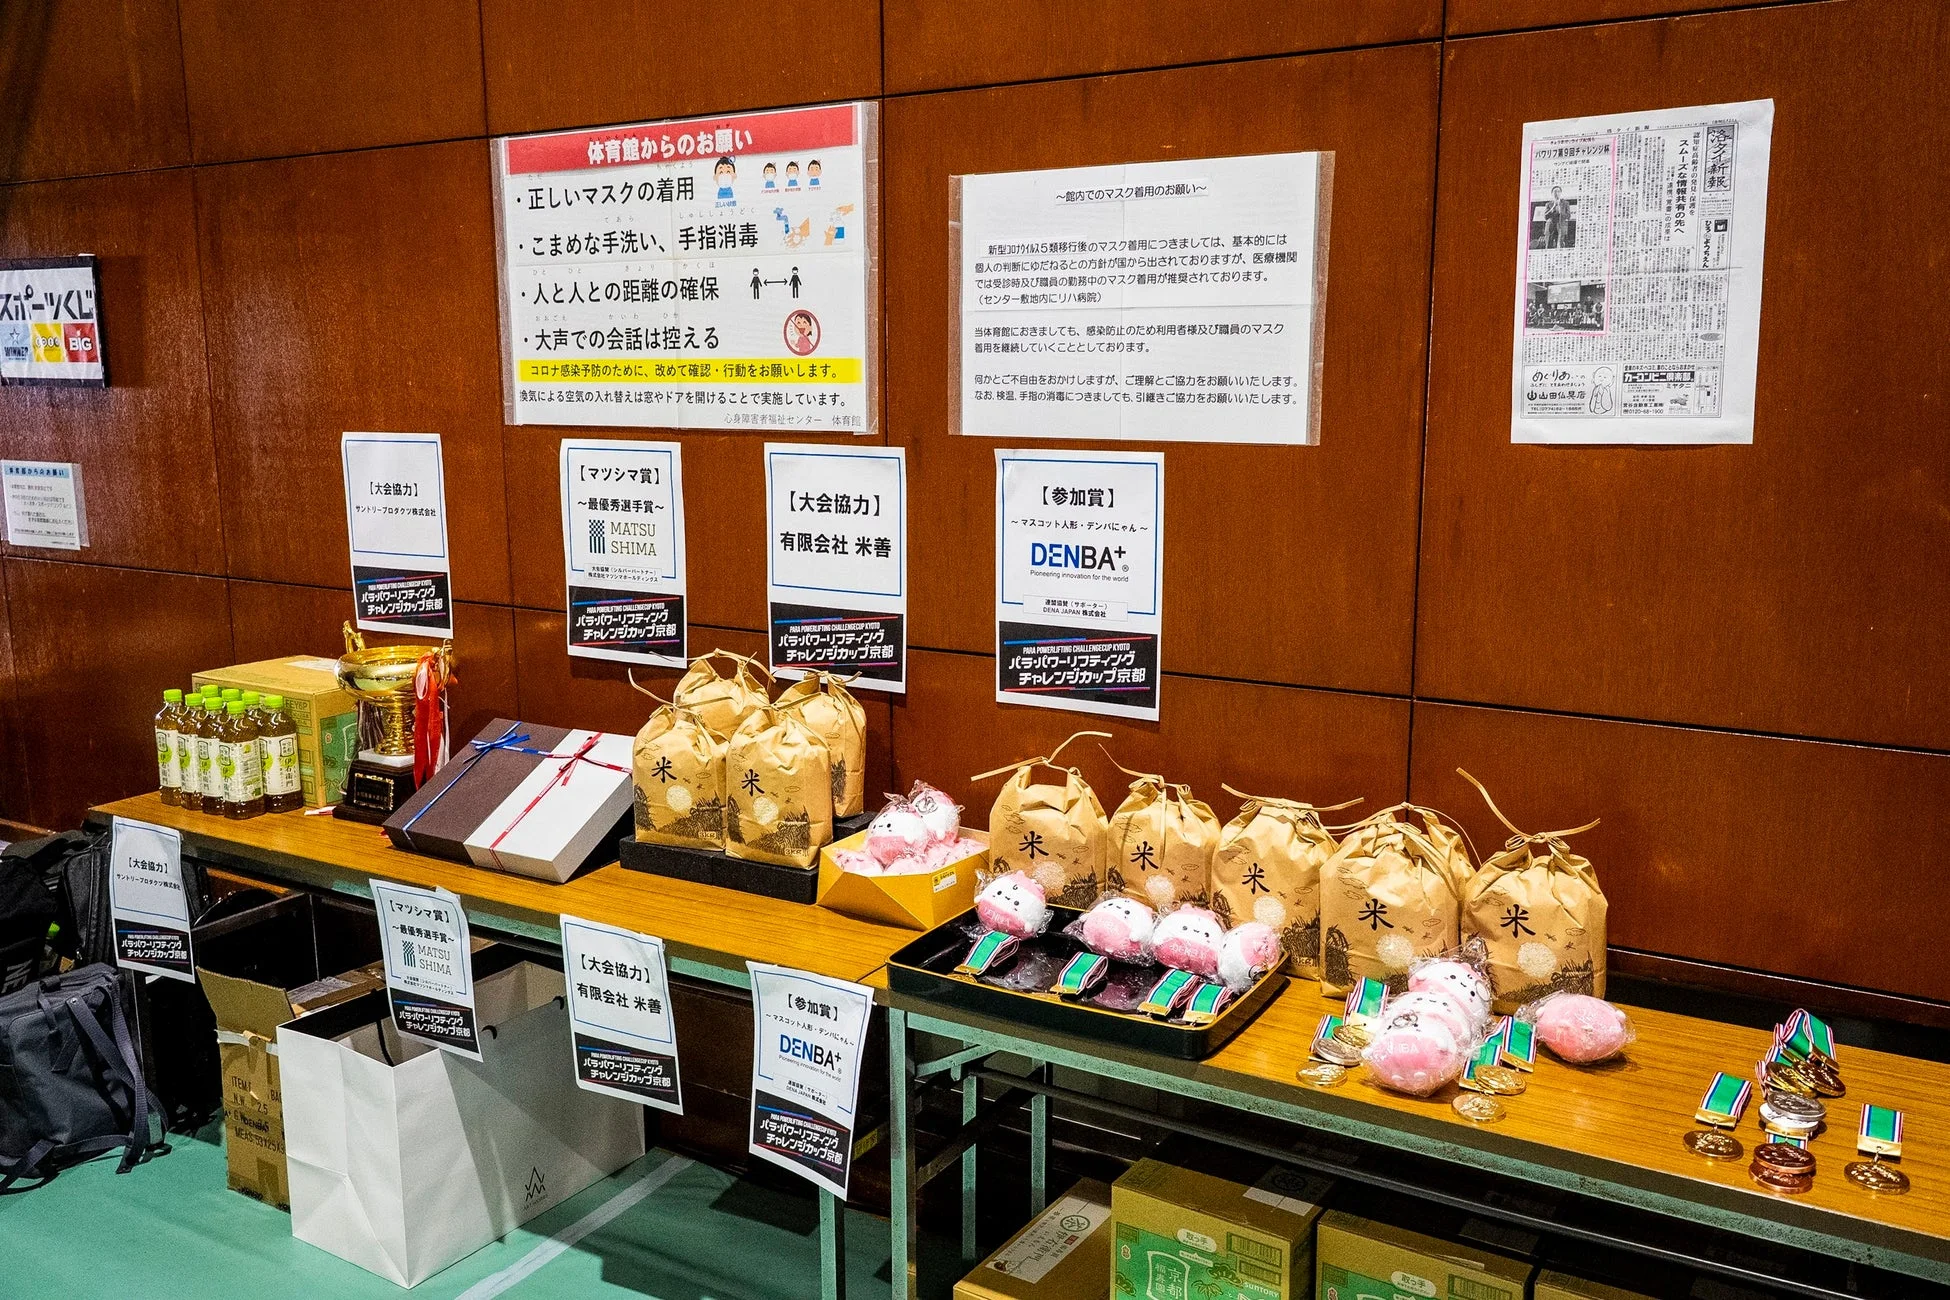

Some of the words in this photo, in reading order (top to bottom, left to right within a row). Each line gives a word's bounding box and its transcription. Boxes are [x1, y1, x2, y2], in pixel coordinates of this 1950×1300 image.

[587, 128, 753, 165] 体育館からのお願い
[1707, 129, 1732, 190] 洛タイ新報
[1674, 139, 1689, 233] スムーズな情報共有の先へ
[974, 323, 1285, 337] 当体育館におきましても、感染防止のため利用者様及び職員のマスク
[69, 337, 93, 351] BIG
[974, 341, 1150, 353] 着用を継続していくこととしております。
[530, 363, 837, 379] コロナ感染予防のために、改めて確認・行動をお願いします。
[974, 374, 1298, 387] 何かとご不自由をおかけしますが、ご理解とご協力をお願いいたします。
[519, 390, 846, 407] 換気による空気の入れ替えは窓やドアを開けることで実施しています。
[724, 413, 822, 426] 心身障害者福祉センター
[831, 415, 862, 427] 体育館
[580, 464, 660, 485] 【マツシマ賞】
[370, 481, 419, 498] 【大会協力】
[1042, 486, 1115, 508] 【参加賞】
[355, 505, 437, 517] サントリープロダクツ株式会社
[788, 490, 881, 517] 【大会協力】
[611, 521, 657, 538] MATSU
[611, 540, 658, 557] SHIMA
[780, 531, 849, 555] 有限会社
[854, 536, 892, 559] 米善
[1030, 569, 1061, 580] Pioneering
[1062, 572, 1092, 581] innovation
[1092, 573, 1102, 581] for
[1102, 573, 1112, 582] the
[1112, 575, 1129, 583] world
[367, 598, 443, 615] チャレンジカップ京都
[1043, 606, 1060, 615] DENA
[1061, 608, 1081, 617] JAPAN
[1082, 609, 1107, 618] 株式会社
[583, 623, 677, 641] チャレンジカップ京都
[789, 625, 801, 633] PARA
[800, 623, 831, 633] POWERLIFTING
[831, 622, 865, 631] CHALLENGECUP
[865, 621, 881, 630] KYOTO
[786, 645, 894, 663] チャレンジカップ京都
[1022, 646, 1036, 654] PARA
[1036, 644, 1072, 654] POWERLIFTING
[1072, 643, 1112, 653] CHALLENGECUP
[1112, 642, 1130, 651] KYOTO
[1018, 667, 1146, 686] チャレンジカップ京都
[651, 756, 677, 784] 米
[741, 768, 765, 797] 米
[1018, 830, 1049, 859] 米
[1130, 840, 1159, 871] 米
[129, 857, 168, 874] 【大会協力】
[1242, 863, 1271, 895] 米
[389, 900, 450, 924] 【マツシマ賞】
[1358, 898, 1395, 931] 米
[1500, 903, 1536, 938] 米
[417, 944, 451, 961] MATSU
[419, 958, 452, 976] SHIMA
[581, 953, 650, 984] 【大会協力】
[577, 983, 630, 1009] 有限会社
[634, 996, 662, 1015] 米善
[787, 993, 839, 1021] 【参加賞】
[406, 1020, 471, 1037] チャレンジカップ京都
[590, 1069, 671, 1087] チャレンジカップ京都
[766, 1133, 843, 1165] チャレンジカップ京都
